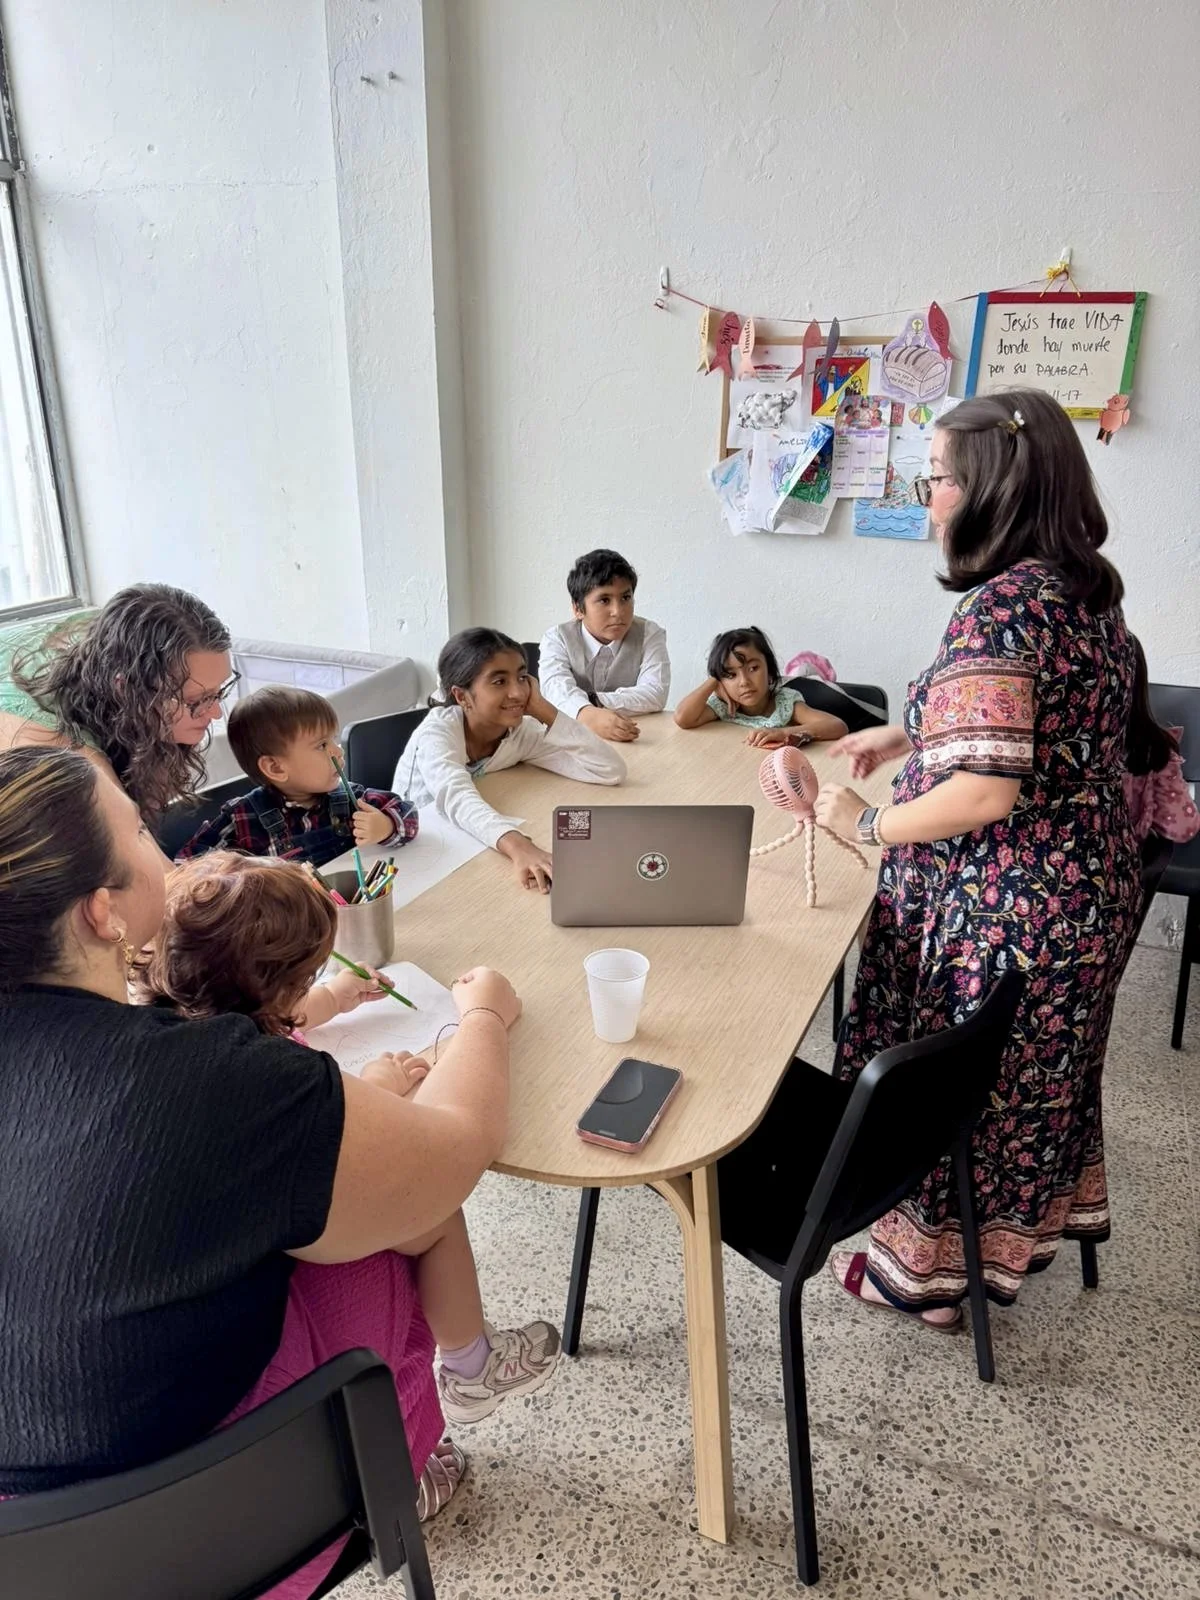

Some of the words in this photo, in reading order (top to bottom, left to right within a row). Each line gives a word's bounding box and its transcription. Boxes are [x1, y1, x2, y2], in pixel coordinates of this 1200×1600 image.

[1001, 312, 1039, 332] Jesús
[1048, 312, 1075, 331] trae
[1085, 310, 1124, 332] VIDA
[996, 338, 1031, 356] donde
[1043, 336, 1063, 360] hay
[1072, 337, 1111, 353] muerte
[987, 362, 1005, 377] por
[1013, 363, 1027, 375] su
[503, 1360, 518, 1378] N
